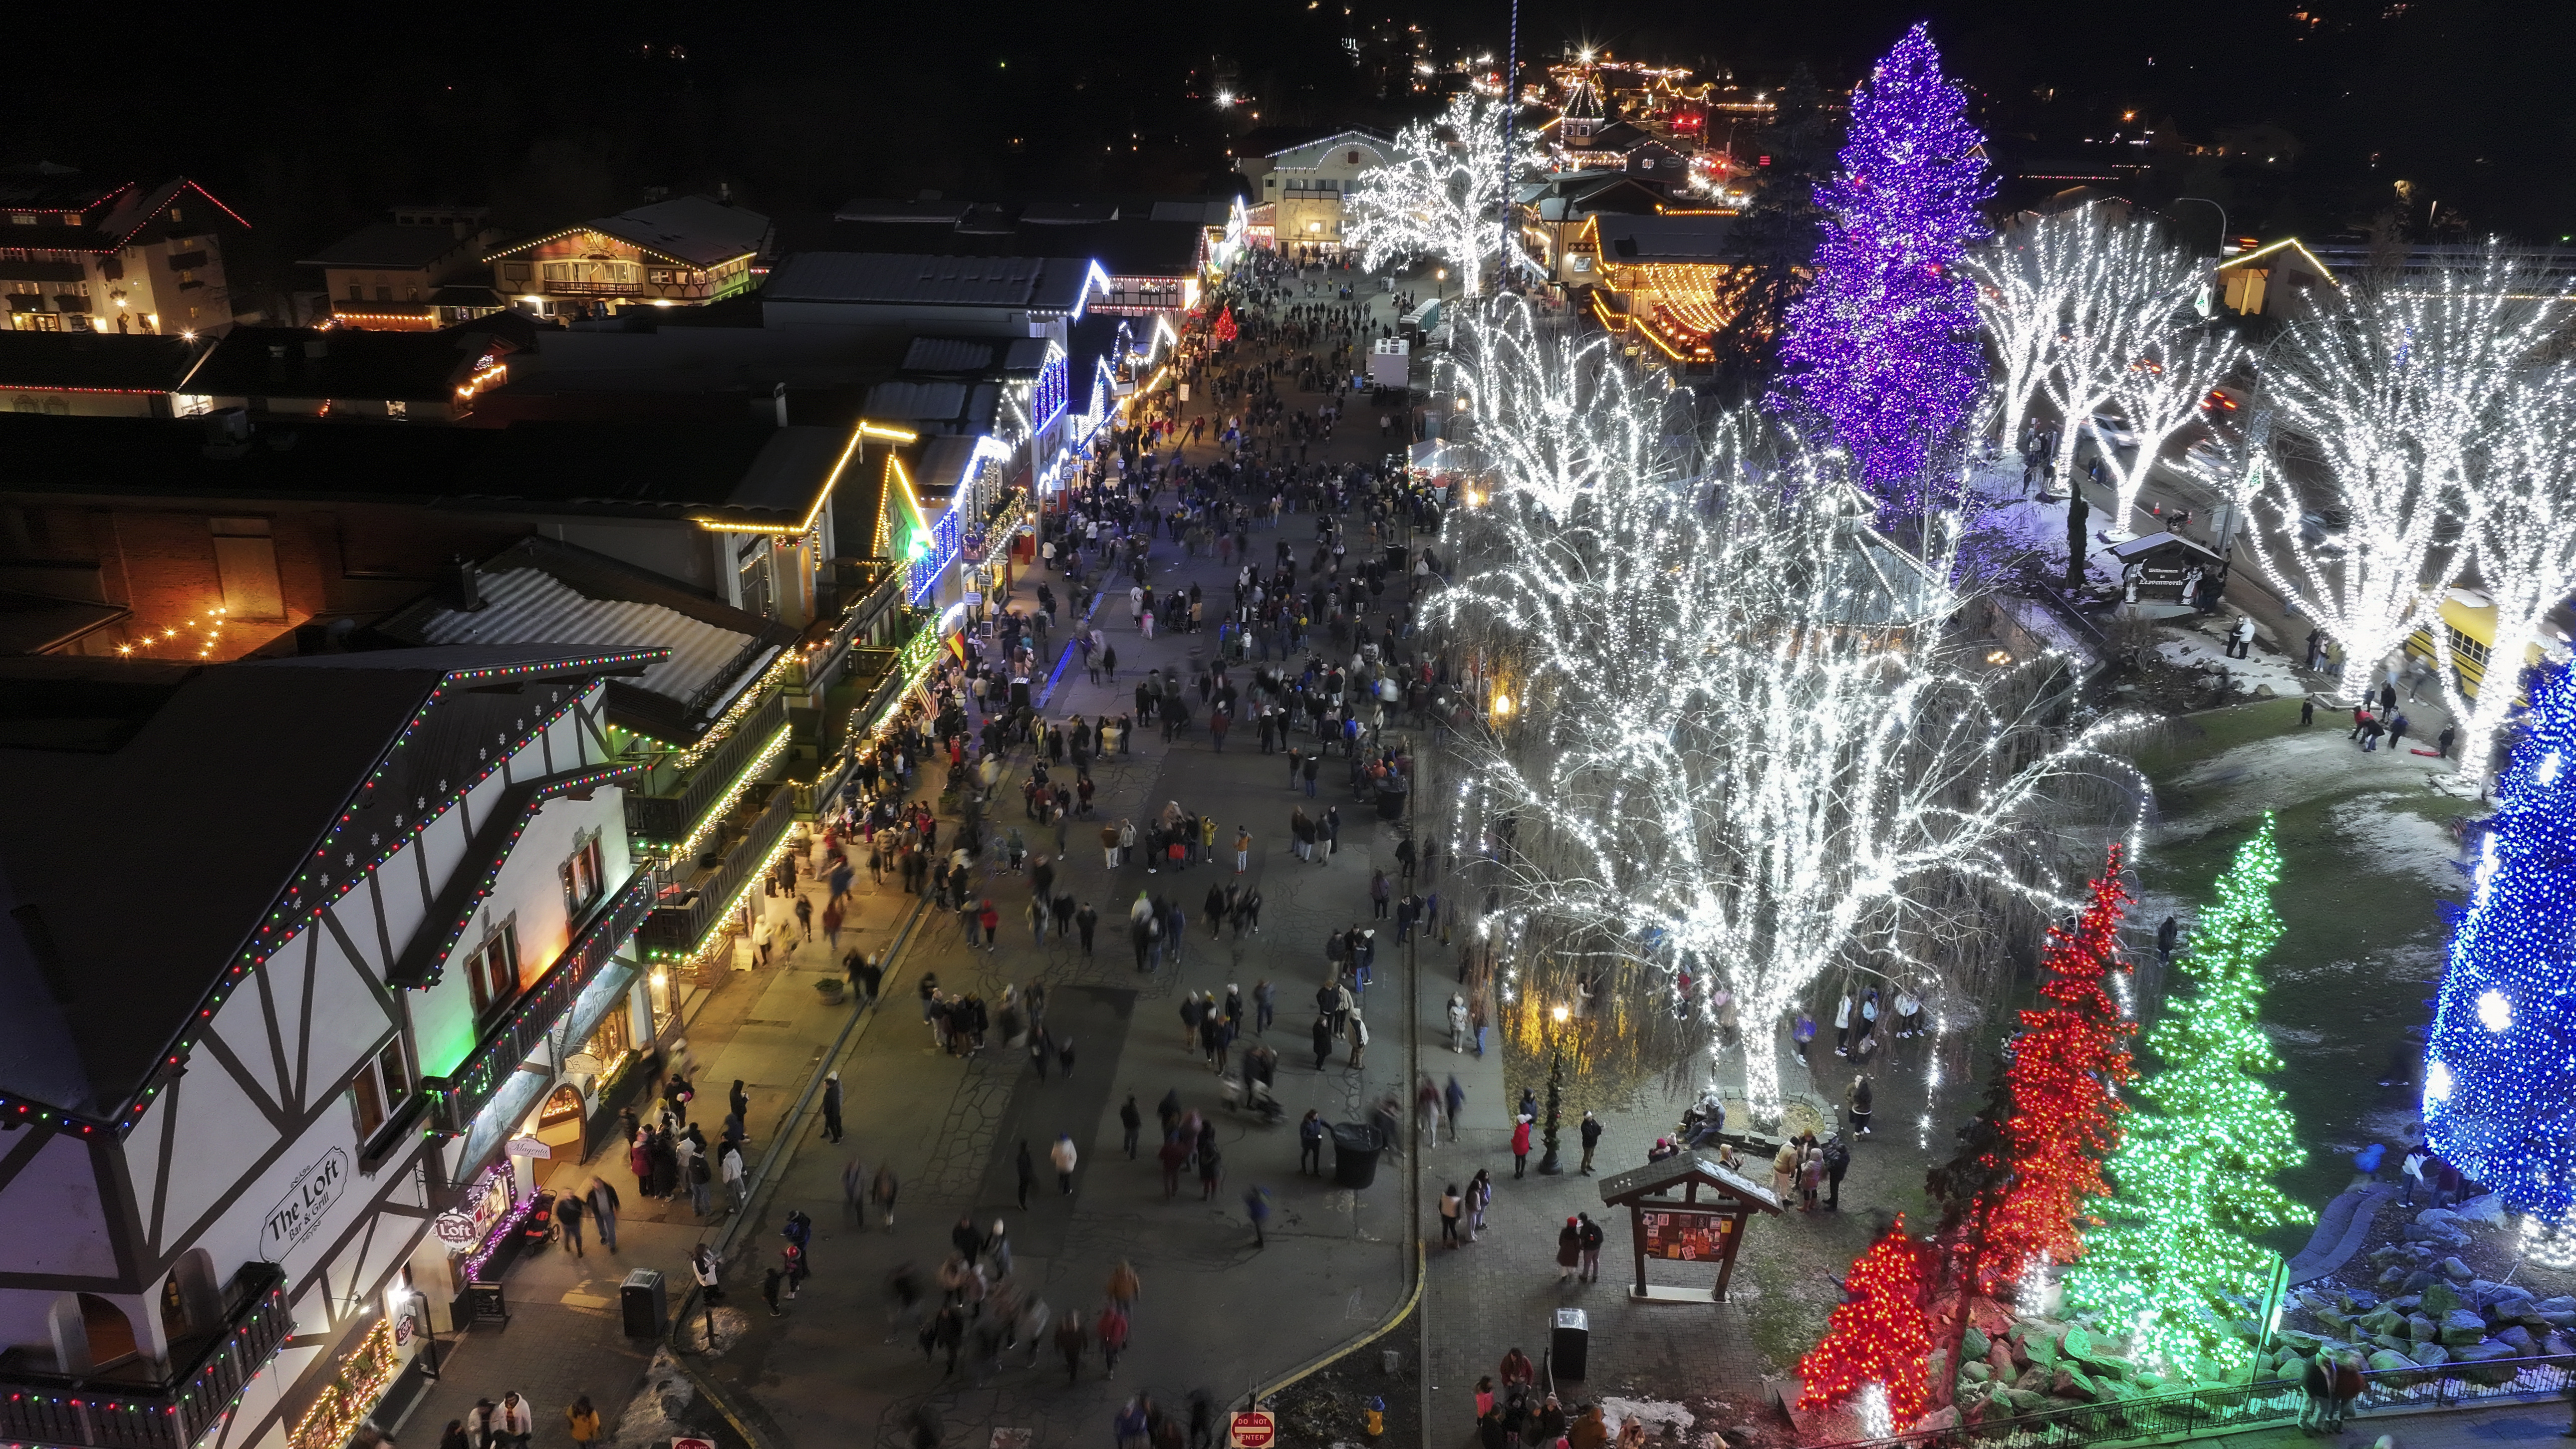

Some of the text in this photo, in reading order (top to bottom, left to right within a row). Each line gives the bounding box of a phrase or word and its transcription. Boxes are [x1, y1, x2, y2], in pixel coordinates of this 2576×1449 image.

[510, 1142, 548, 1156] Magenta
[268, 1158, 339, 1241] The Loft
[289, 1192, 329, 1241] Bar & Grill
[440, 1223, 472, 1236] Loft
